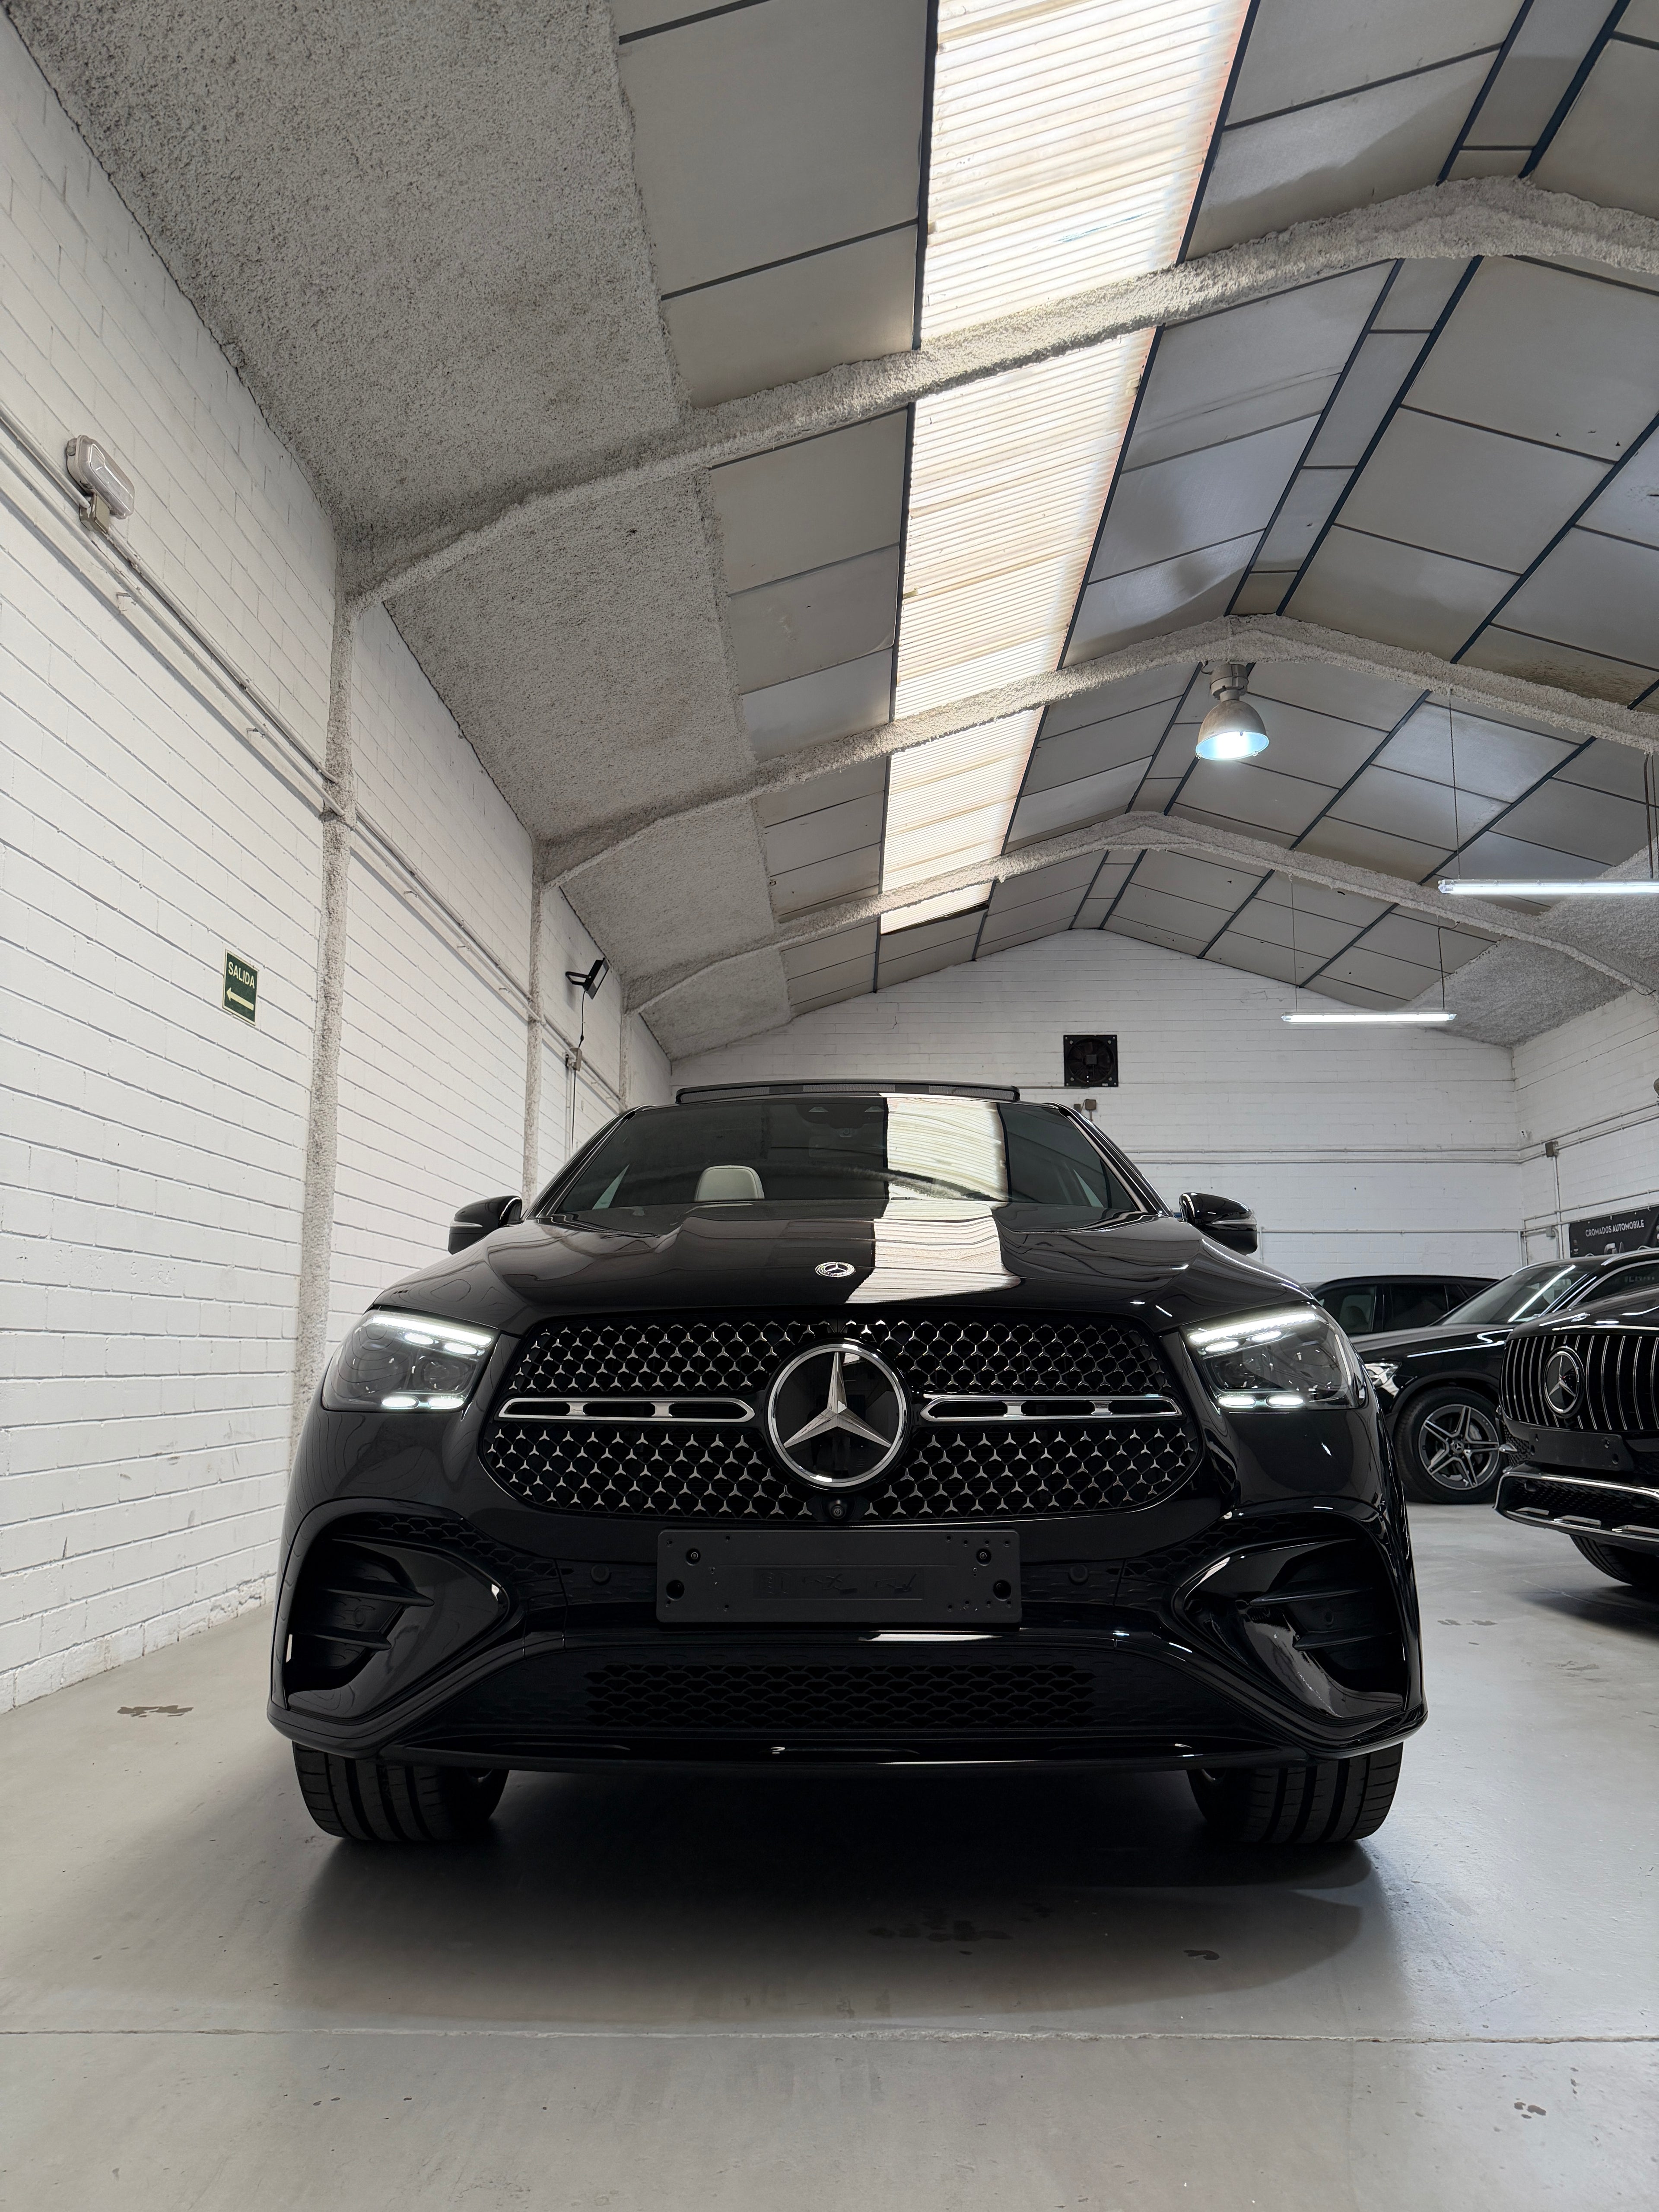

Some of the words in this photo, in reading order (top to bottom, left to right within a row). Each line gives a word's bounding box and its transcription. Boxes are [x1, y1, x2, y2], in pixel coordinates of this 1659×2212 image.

[229, 962, 254, 988] SALIDA
[1585, 1226, 1612, 1237] CROMADOS
[1612, 1219, 1644, 1233] AUTOMOBILE
